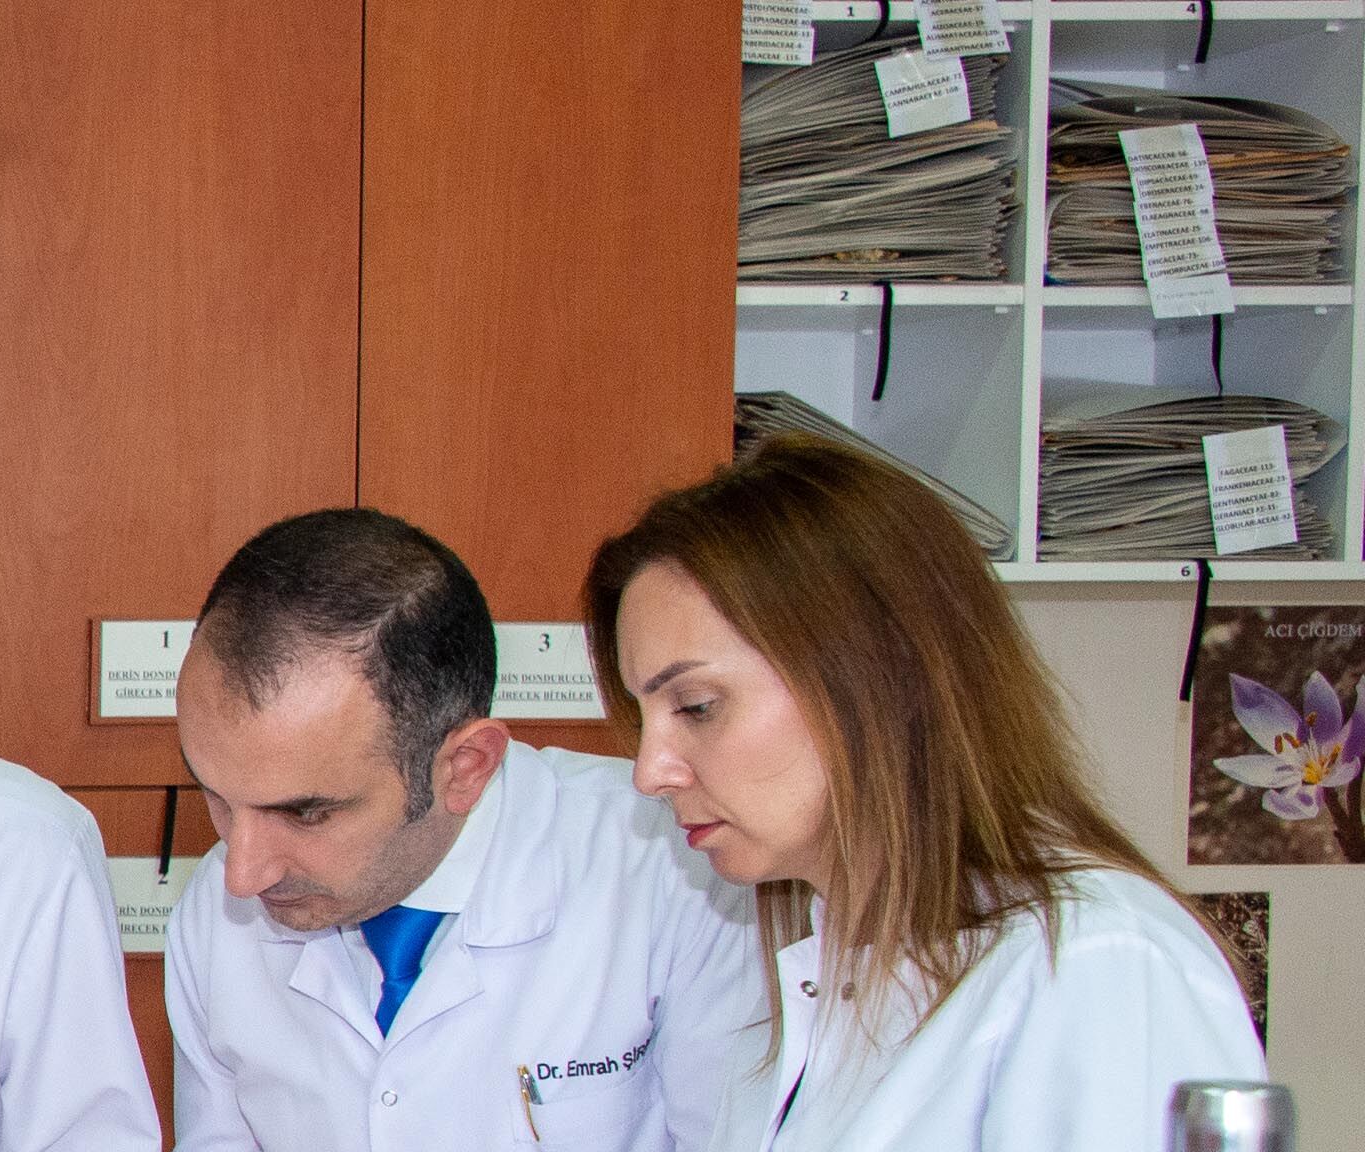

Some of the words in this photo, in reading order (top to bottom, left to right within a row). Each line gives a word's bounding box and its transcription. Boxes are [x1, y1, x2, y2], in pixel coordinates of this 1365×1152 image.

[846, 6, 855, 17] 1
[1186, 2, 1196, 14] 4
[840, 290, 849, 301] 2
[1180, 565, 1191, 577] 6
[1264, 623, 1295, 638] ACI
[162, 631, 170, 649] 1
[538, 633, 551, 653] 3
[536, 1062, 564, 1080] Dr.
[566, 1056, 619, 1078] Emrah
